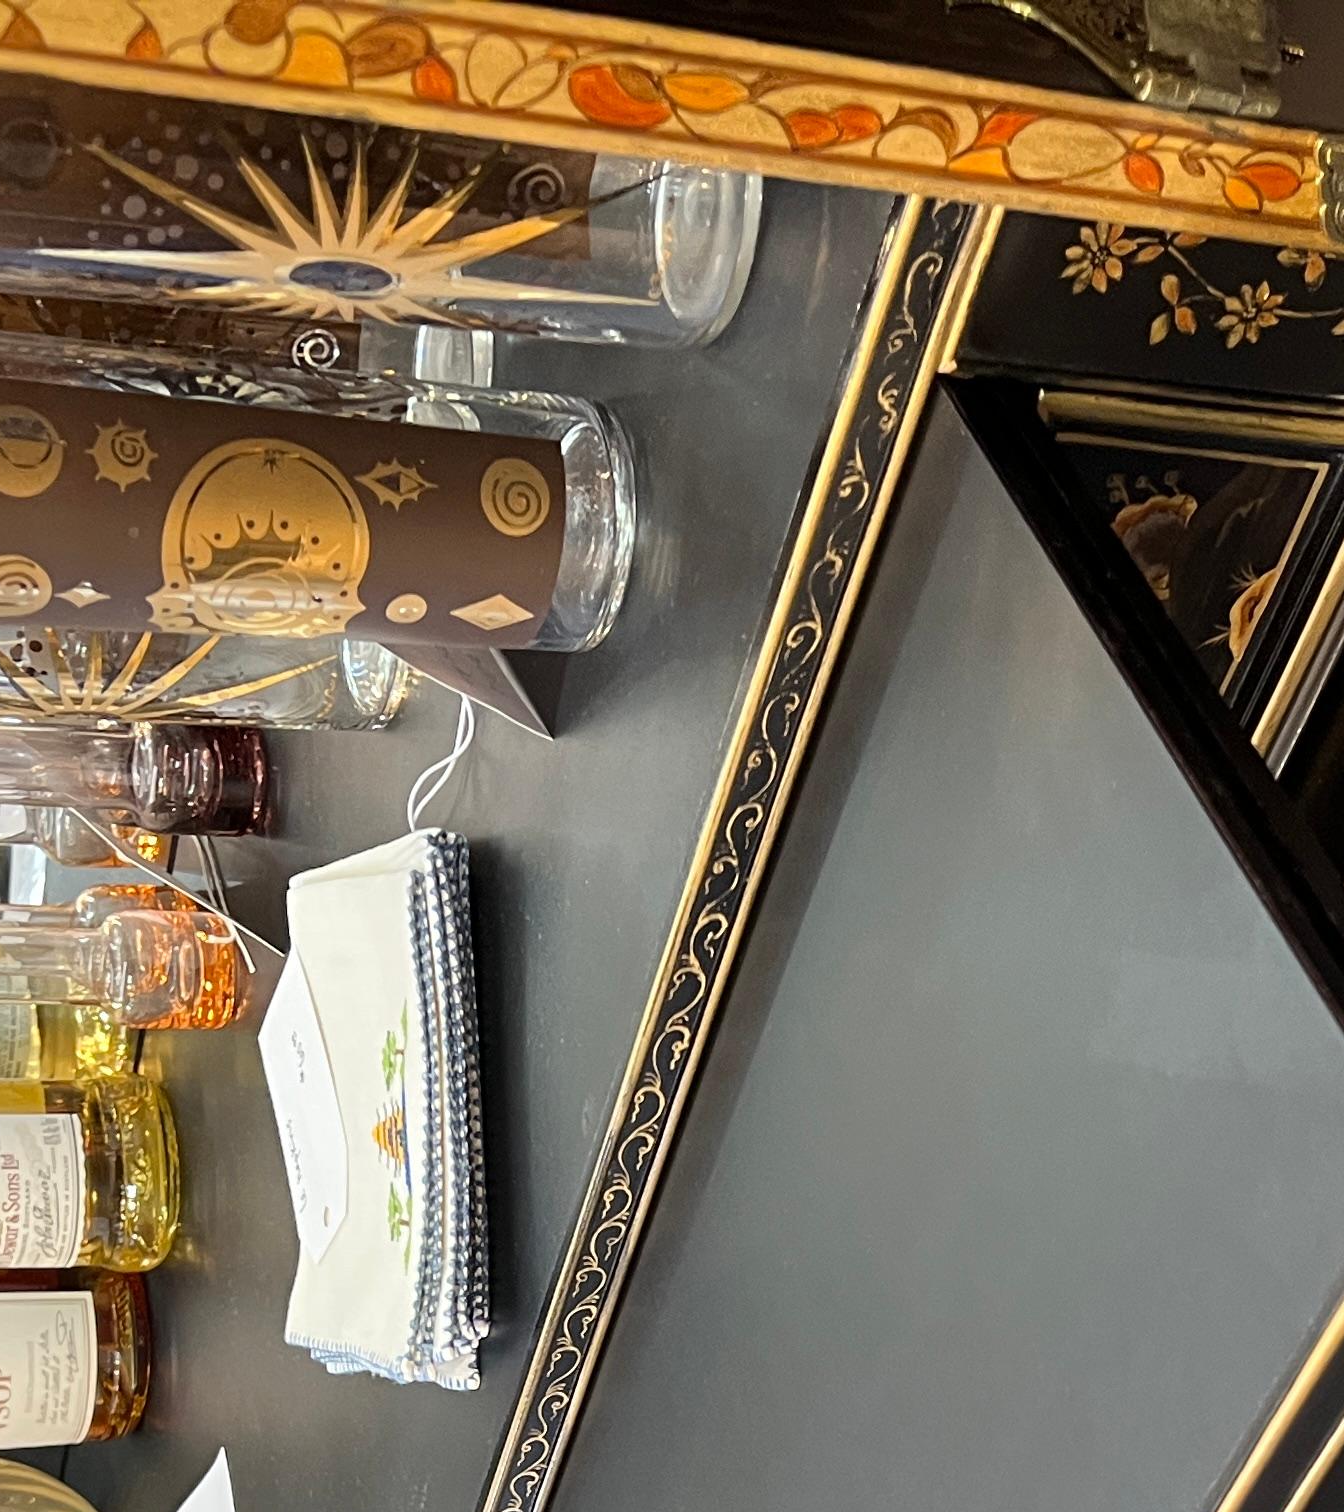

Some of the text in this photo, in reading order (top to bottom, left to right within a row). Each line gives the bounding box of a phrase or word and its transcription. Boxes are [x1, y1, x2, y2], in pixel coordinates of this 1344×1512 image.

[0, 1154, 19, 1170] Ltd
[1, 1173, 20, 1212] Sons
[5, 1214, 20, 1223] &
